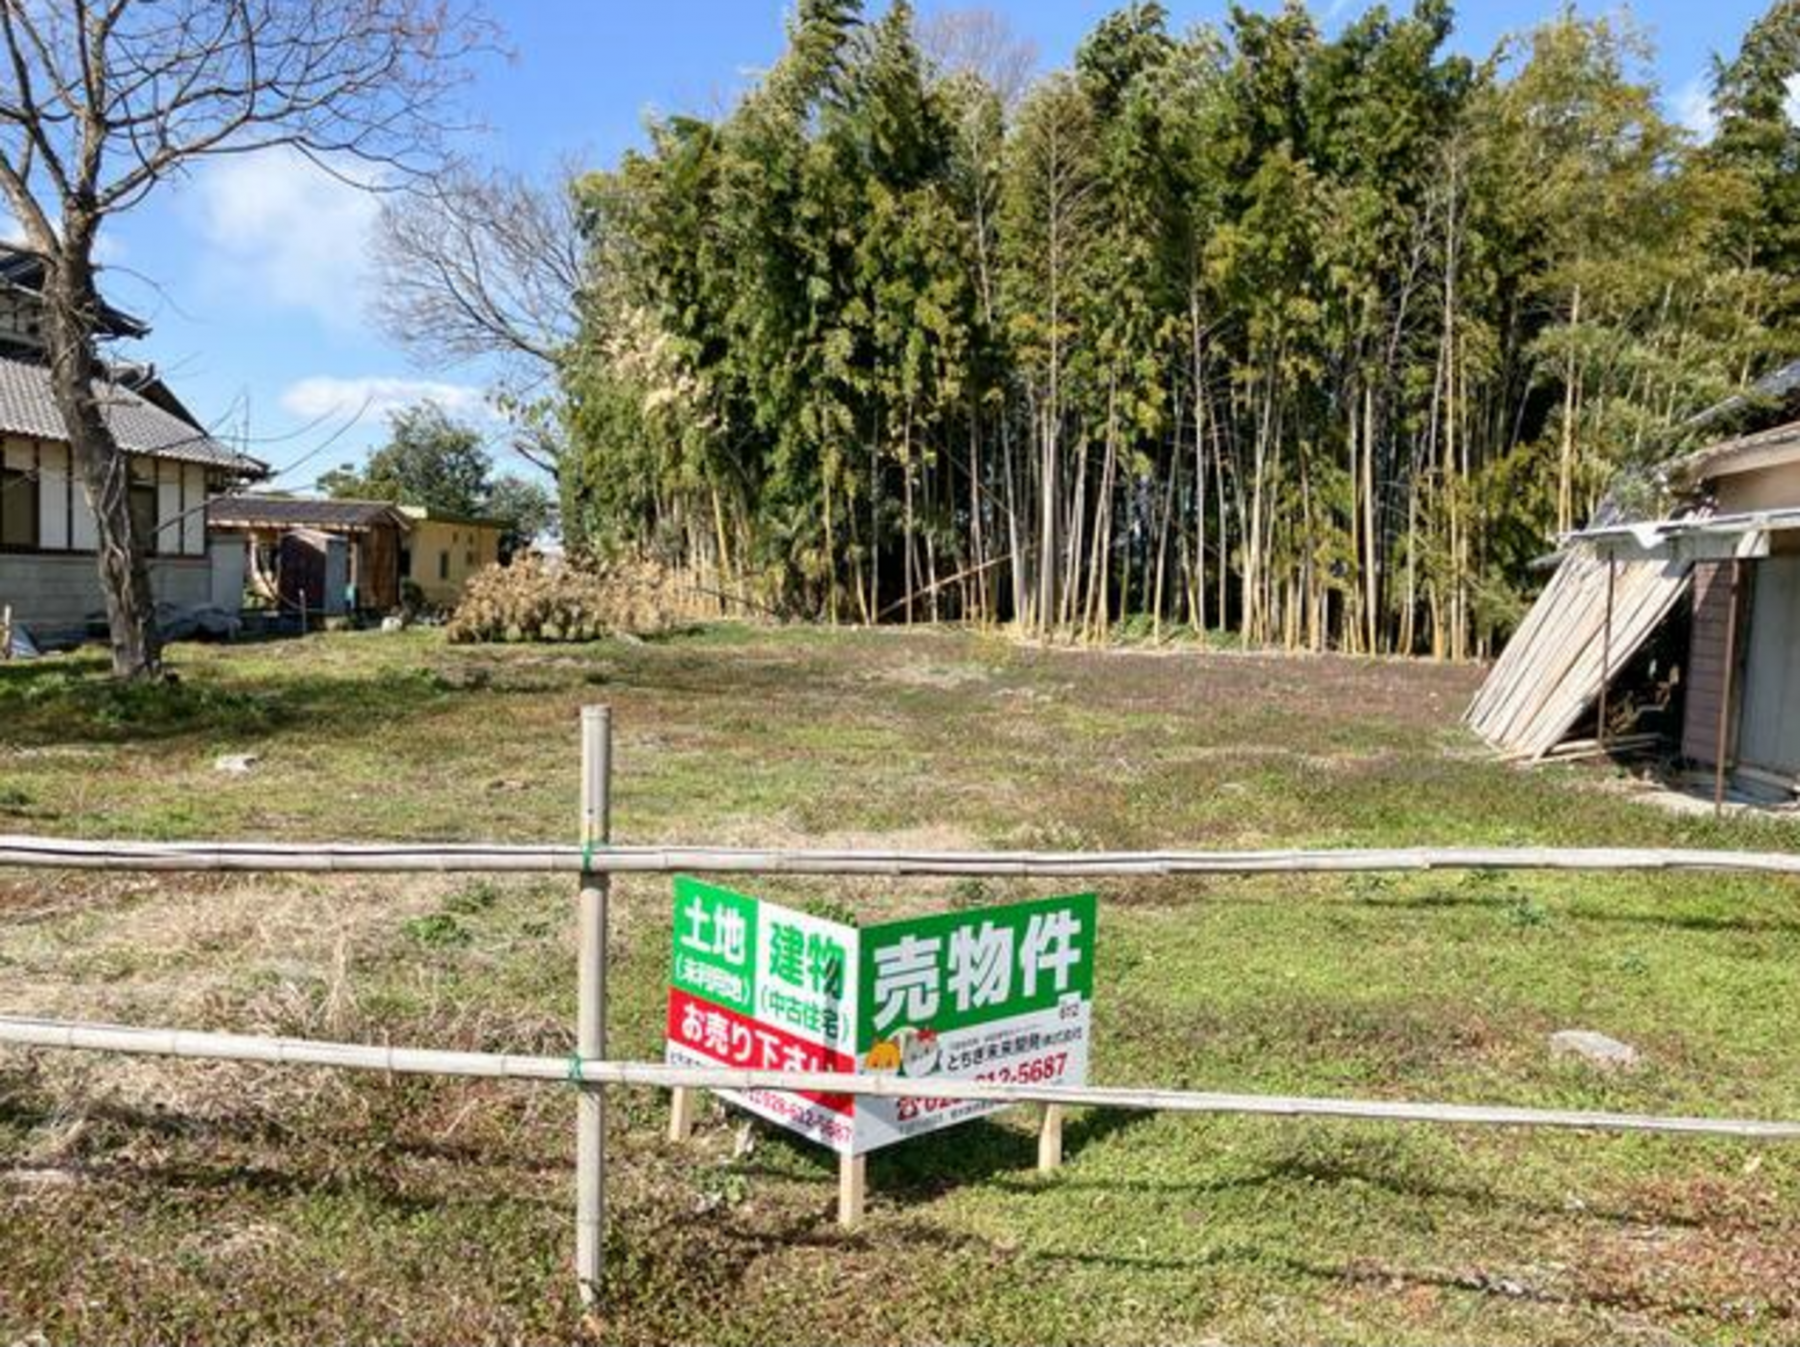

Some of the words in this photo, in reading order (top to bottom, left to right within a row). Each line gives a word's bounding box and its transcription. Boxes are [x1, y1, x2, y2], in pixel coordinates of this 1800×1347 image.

[680, 896, 746, 965] 土地
[769, 921, 846, 1001] 建物
[872, 908, 1083, 1032] 売物件
